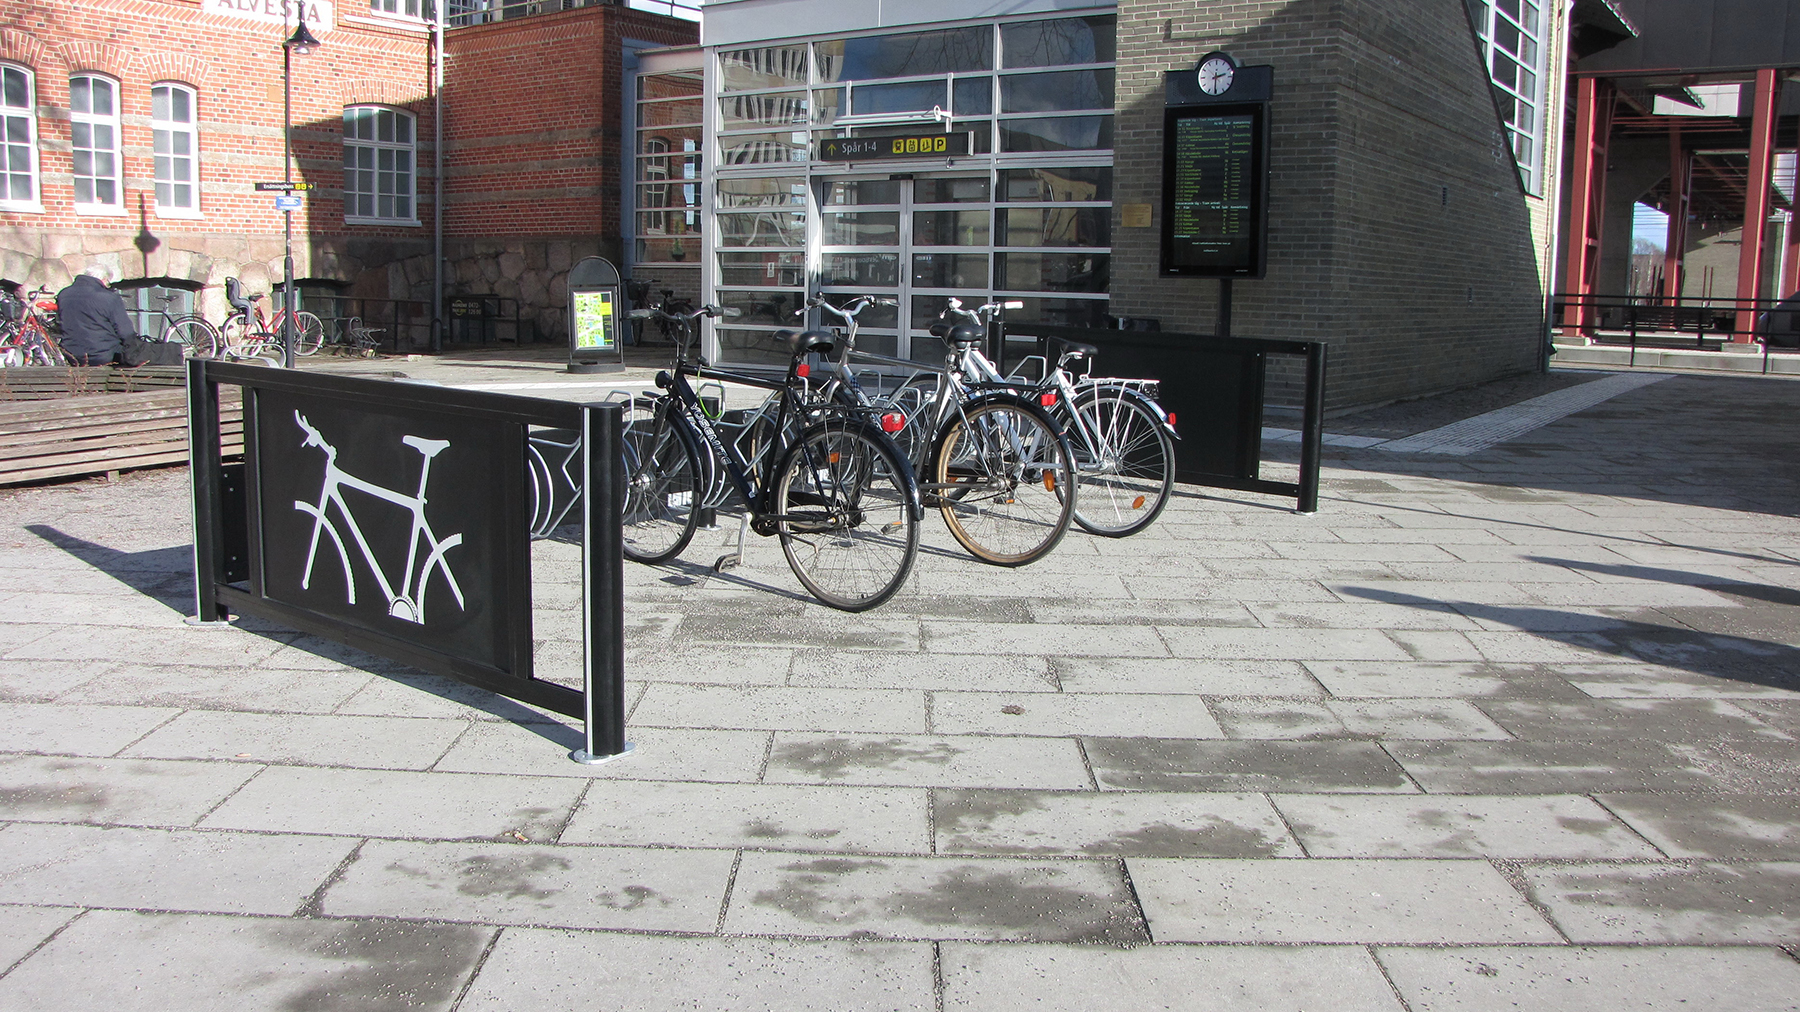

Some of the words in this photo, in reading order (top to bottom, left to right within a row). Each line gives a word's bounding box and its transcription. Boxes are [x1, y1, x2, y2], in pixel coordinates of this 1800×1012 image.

[842, 141, 861, 155] Spår
[864, 141, 877, 152] 1-4
[690, 402, 732, 466] YOSEMITE
